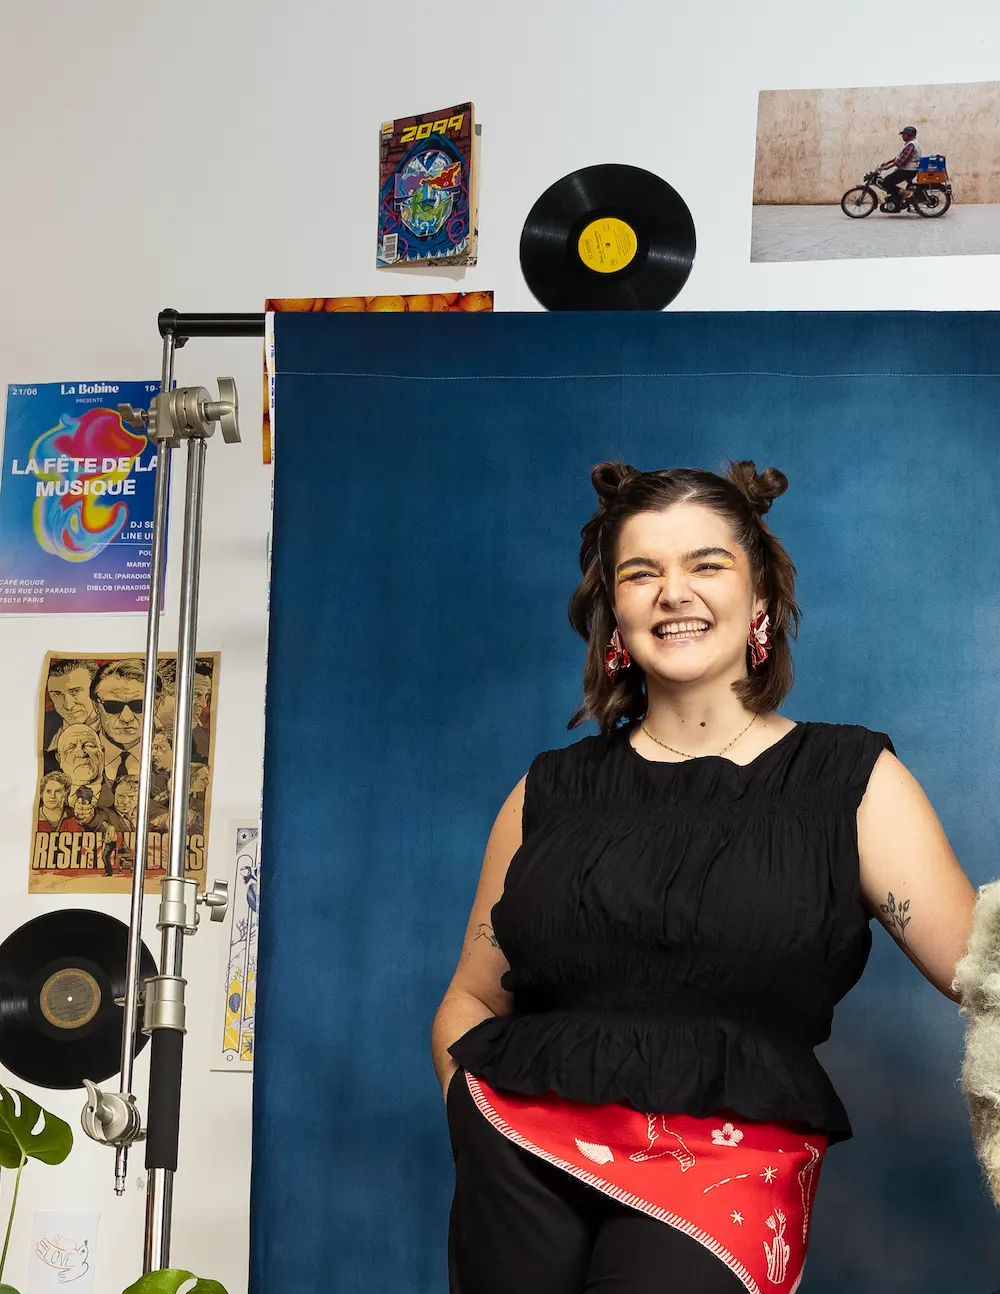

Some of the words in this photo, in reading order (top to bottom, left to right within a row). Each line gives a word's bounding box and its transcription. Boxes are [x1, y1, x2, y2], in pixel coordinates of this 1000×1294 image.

[400, 114, 464, 143] 2099
[12, 388, 38, 396] 21/06
[61, 384, 76, 396] La
[78, 382, 120, 395] Bobine
[12, 458, 40, 475] LA
[44, 455, 98, 475] FÊTE
[102, 457, 131, 473] DE
[134, 456, 158, 472] LA
[35, 478, 136, 497] MUSIQUE
[121, 532, 142, 540] LINE
[43, 1246, 75, 1267] LOVE
